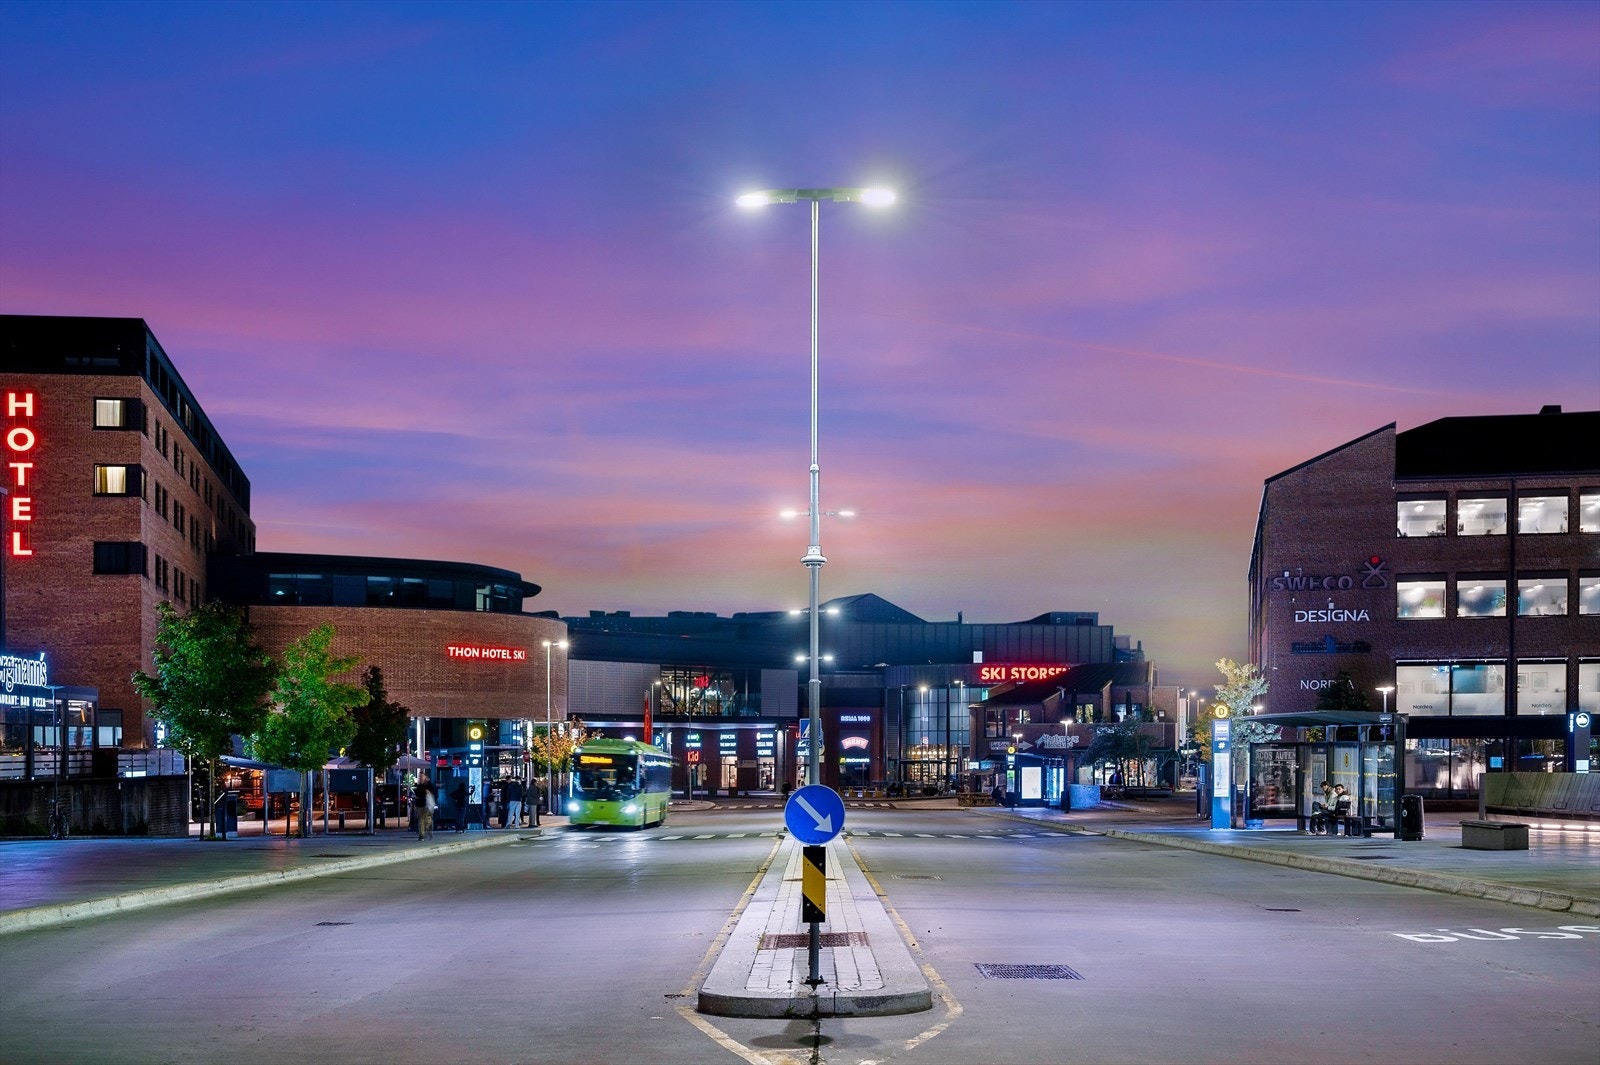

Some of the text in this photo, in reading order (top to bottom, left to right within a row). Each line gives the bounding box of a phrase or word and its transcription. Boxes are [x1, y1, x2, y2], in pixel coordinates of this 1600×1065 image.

[7, 392, 35, 556] HOTEL
[1272, 575, 1354, 592] SWECO
[1295, 609, 1370, 623] DESIGNA
[448, 646, 525, 660] THON HOTEL SKI
[981, 667, 1006, 680] SKI
